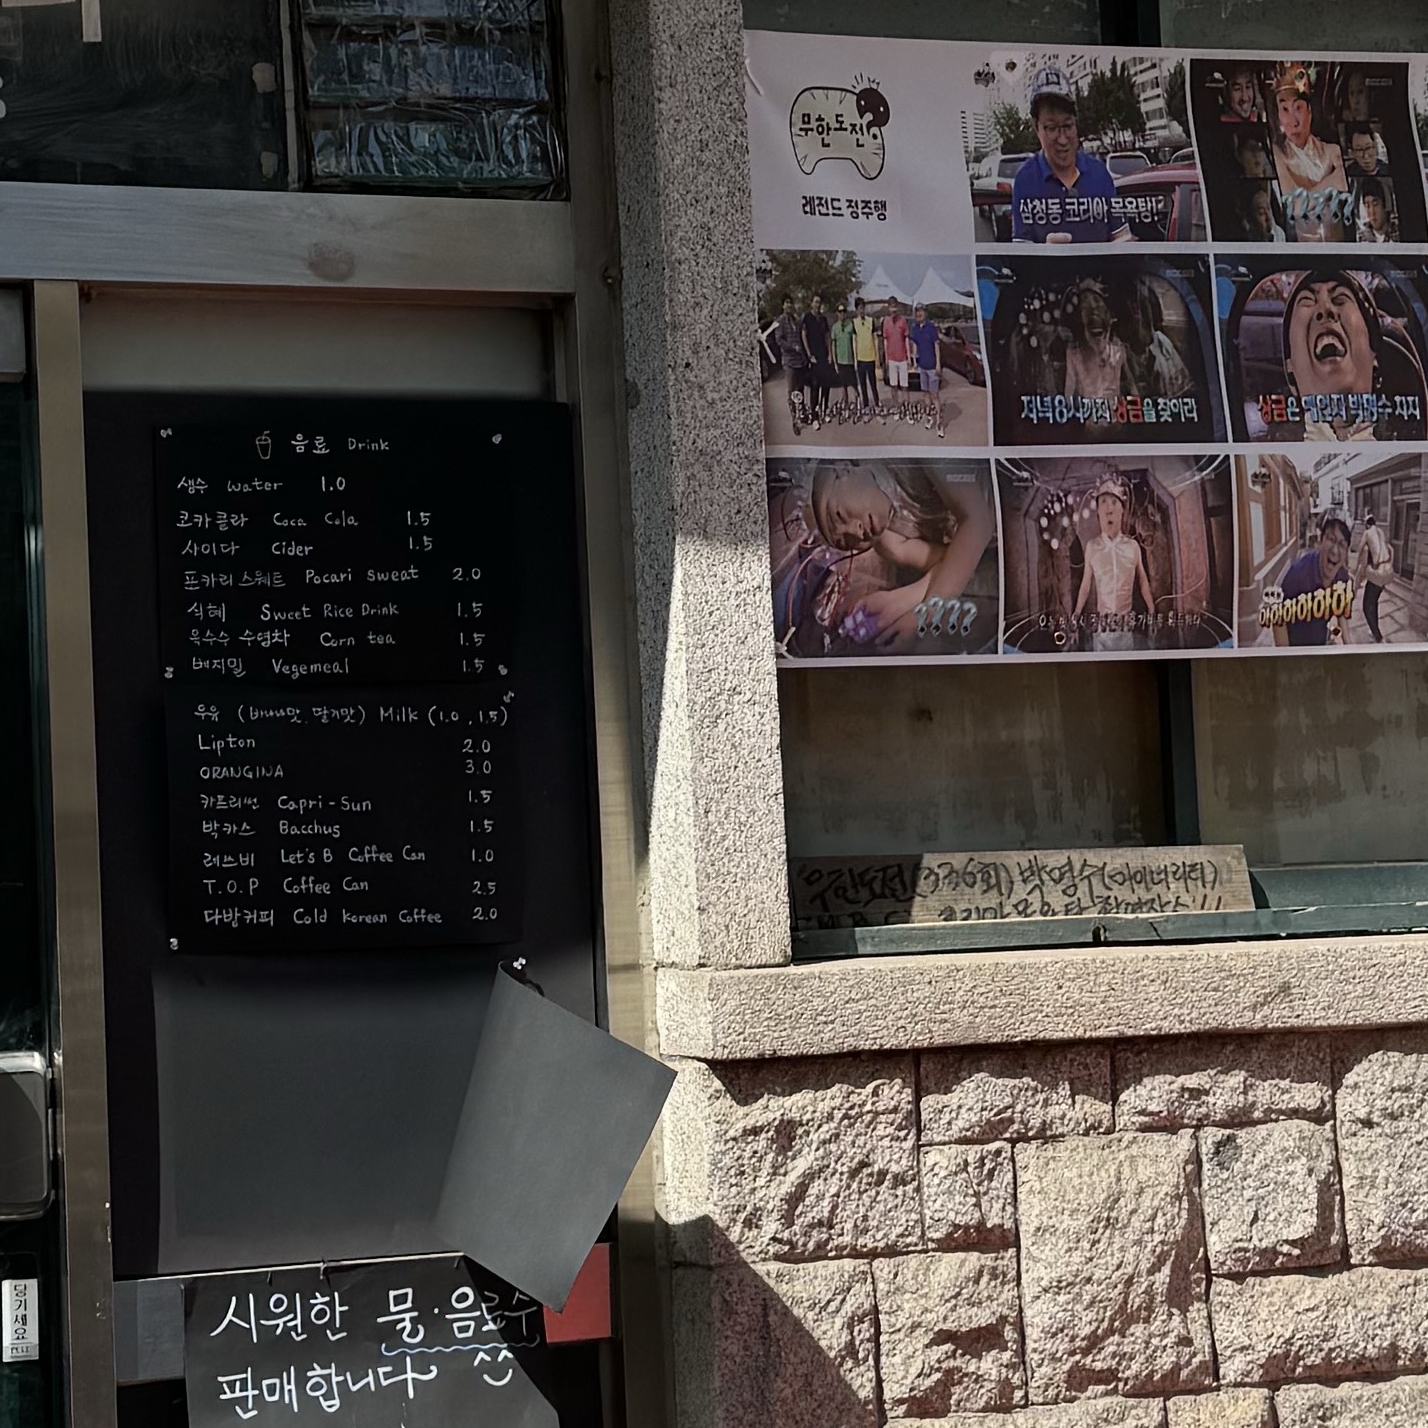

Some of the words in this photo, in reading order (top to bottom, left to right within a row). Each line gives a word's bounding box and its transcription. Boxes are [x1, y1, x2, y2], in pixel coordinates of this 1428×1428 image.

[799, 112, 865, 148] 무한도전
[801, 195, 845, 218] 레전드
[845, 198, 887, 221] 정주행
[1019, 197, 1063, 225] 삼청동
[1064, 197, 1109, 224] 코리아
[1258, 394, 1300, 422] 상금은
[1394, 395, 1421, 420] 차지
[290, 434, 331, 455] 음료
[347, 438, 390, 452] Drink
[177, 476, 209, 495] 생수
[320, 475, 346, 492] 1.0
[175, 510, 248, 531] 코카콜라
[273, 512, 308, 528] Coca
[324, 510, 359, 528] Cola
[406, 510, 431, 527] 1.5
[181, 539, 241, 557] 사이다
[272, 541, 313, 557] Cider
[409, 535, 433, 552] 1.5
[305, 568, 352, 585] Pocari
[452, 567, 481, 581] 2.0
[187, 601, 227, 622] 식혜
[260, 604, 312, 621] Sweet
[323, 602, 354, 618] Rice
[362, 602, 400, 618] Drink
[457, 602, 484, 618] 1.5
[189, 628, 231, 646] 옥수수
[320, 632, 355, 646] Corn
[367, 630, 396, 644] tea
[459, 631, 485, 646] 1.5
[192, 656, 246, 678] 베지밀
[272, 657, 350, 679] Vegemeal
[462, 659, 485, 673] 1.5
[194, 704, 221, 722] 우유
[379, 707, 419, 724] Milk
[198, 734, 256, 757] Lipton
[462, 738, 491, 754] 2.0
[200, 764, 284, 779] ORANGINA
[465, 761, 492, 775] 3.0
[200, 793, 260, 810] 카프리썬
[468, 789, 492, 804] 1.5
[202, 820, 256, 838] 박카스
[279, 820, 341, 838] Bacchus
[469, 818, 494, 833] 1.5
[203, 852, 255, 869] 레쓰비
[281, 848, 316, 864] Let's
[323, 848, 333, 863] B
[348, 846, 394, 863] Coffee
[402, 845, 426, 861] Can
[471, 848, 494, 863] 1.0
[203, 878, 259, 896] T.O.P
[283, 877, 331, 895] Coffee
[342, 877, 369, 892] Can
[472, 881, 496, 895] 2.5
[204, 909, 274, 927] 다방커피
[293, 909, 327, 924] Cold
[399, 909, 443, 924] Coffee
[472, 908, 498, 921] 2.0
[13, 1283, 28, 1342] 당기세요
[210, 1292, 349, 1344] 시원한
